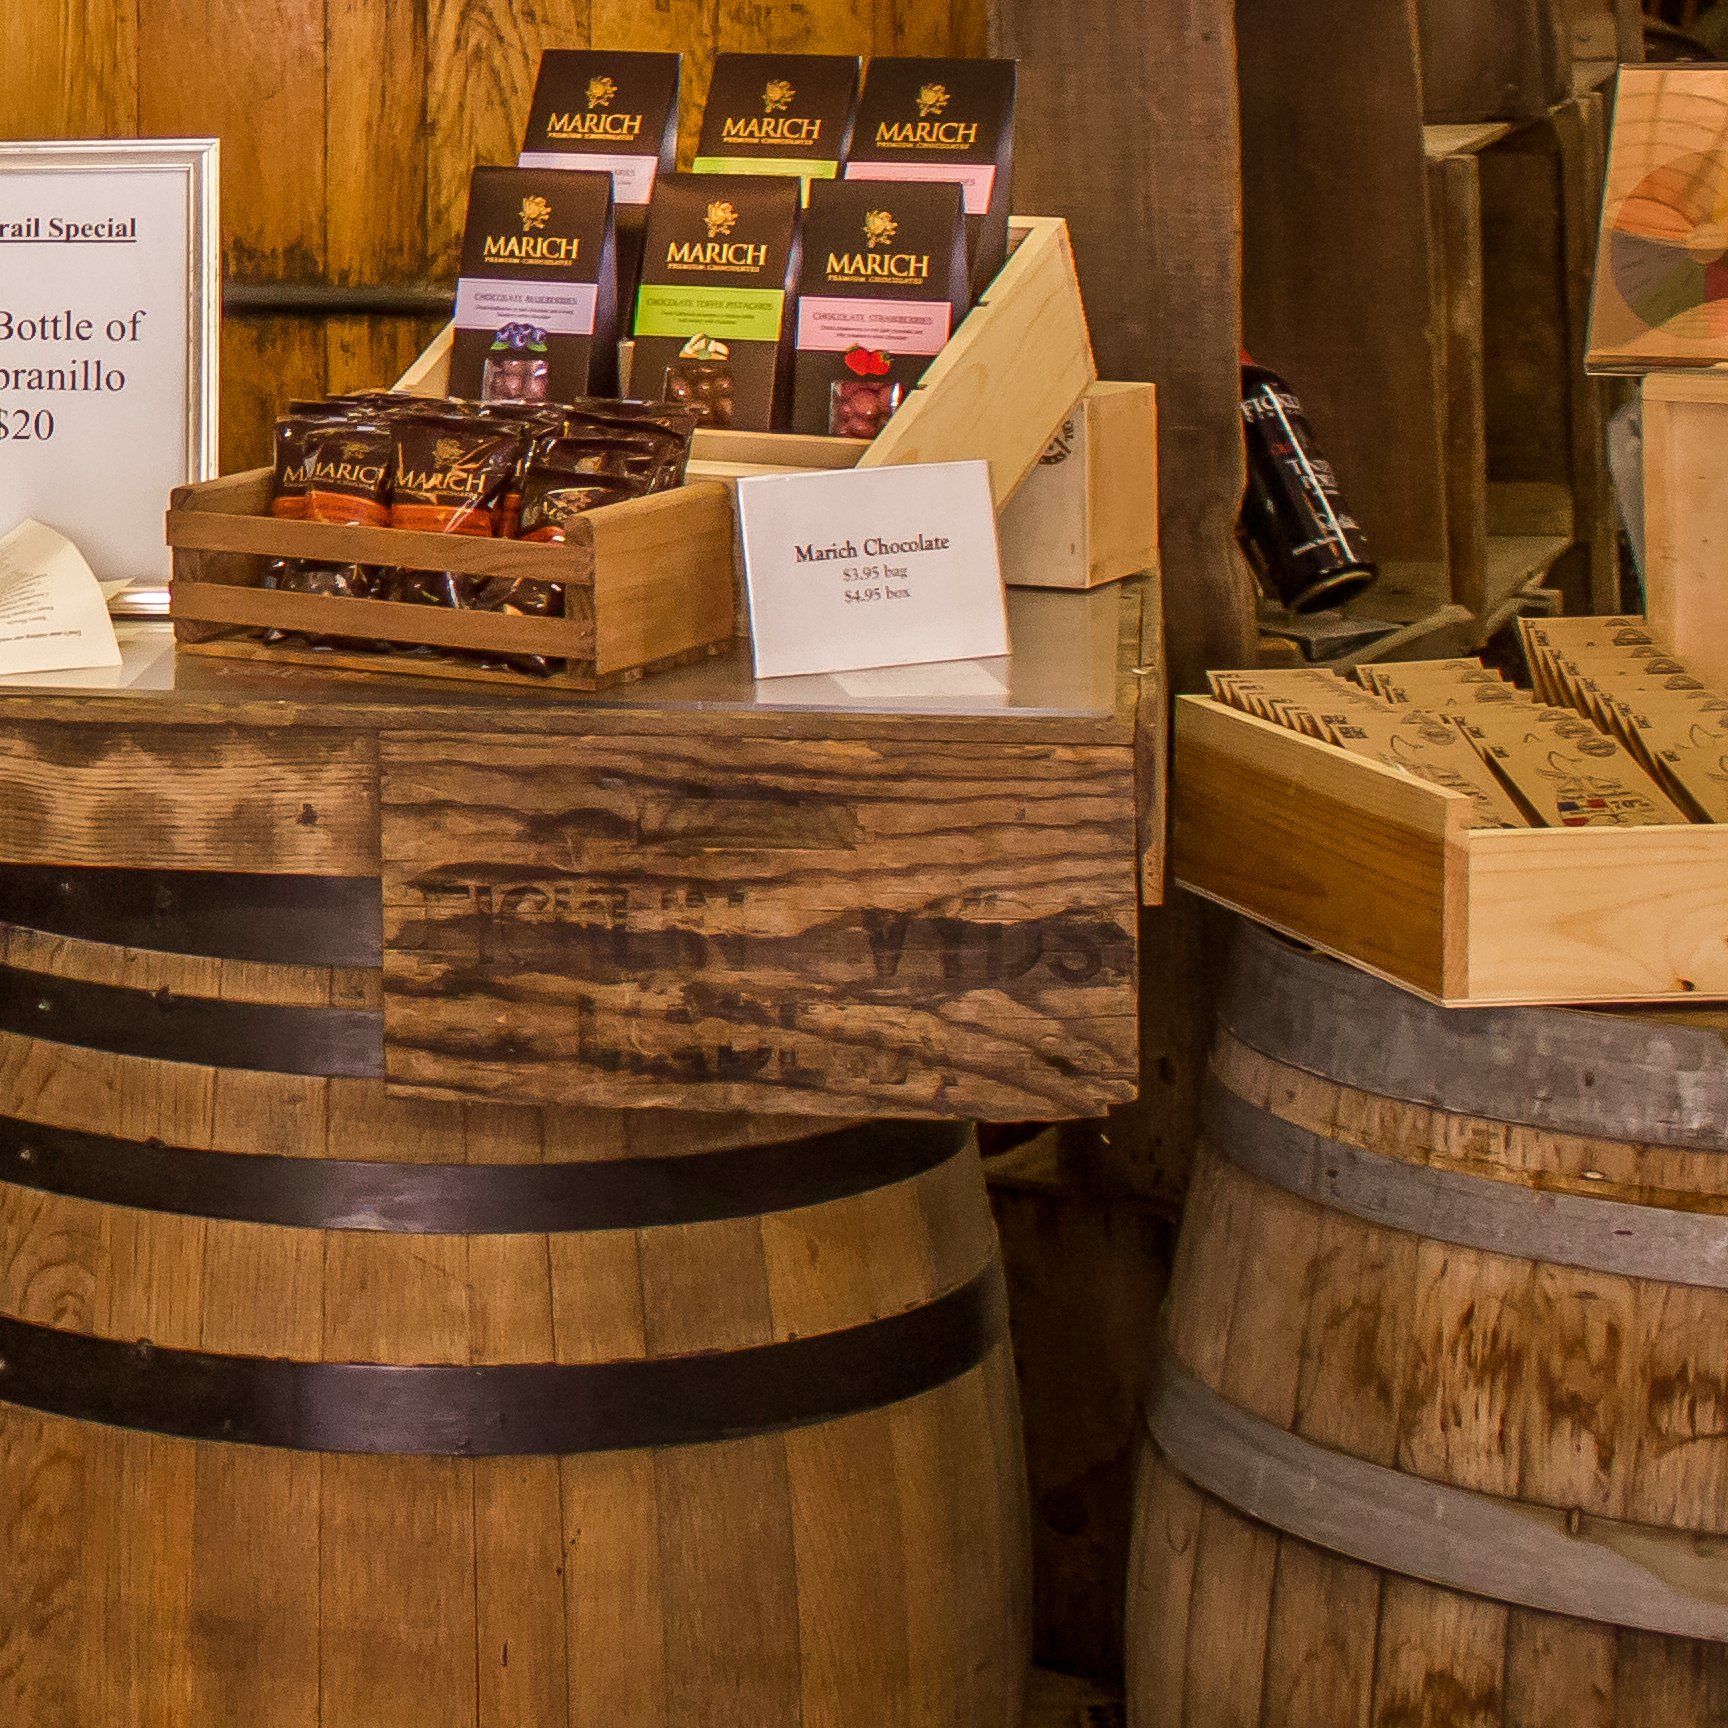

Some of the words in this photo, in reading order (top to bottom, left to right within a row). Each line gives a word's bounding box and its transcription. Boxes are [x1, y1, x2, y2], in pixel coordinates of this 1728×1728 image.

[546, 111, 642, 136] MARICH
[721, 116, 822, 140] MARICH
[875, 120, 977, 144] MARICH
[48, 217, 136, 243] Special
[484, 235, 580, 260] MARICH
[667, 241, 768, 266] MARICH
[826, 252, 929, 277] MARICH
[105, 309, 147, 342] of
[794, 540, 857, 563] Marich
[863, 533, 950, 557] Chocolate
[843, 565, 880, 582] $3.95
[883, 563, 908, 579] bag
[844, 587, 882, 603] $4.95
[885, 585, 911, 600] box
